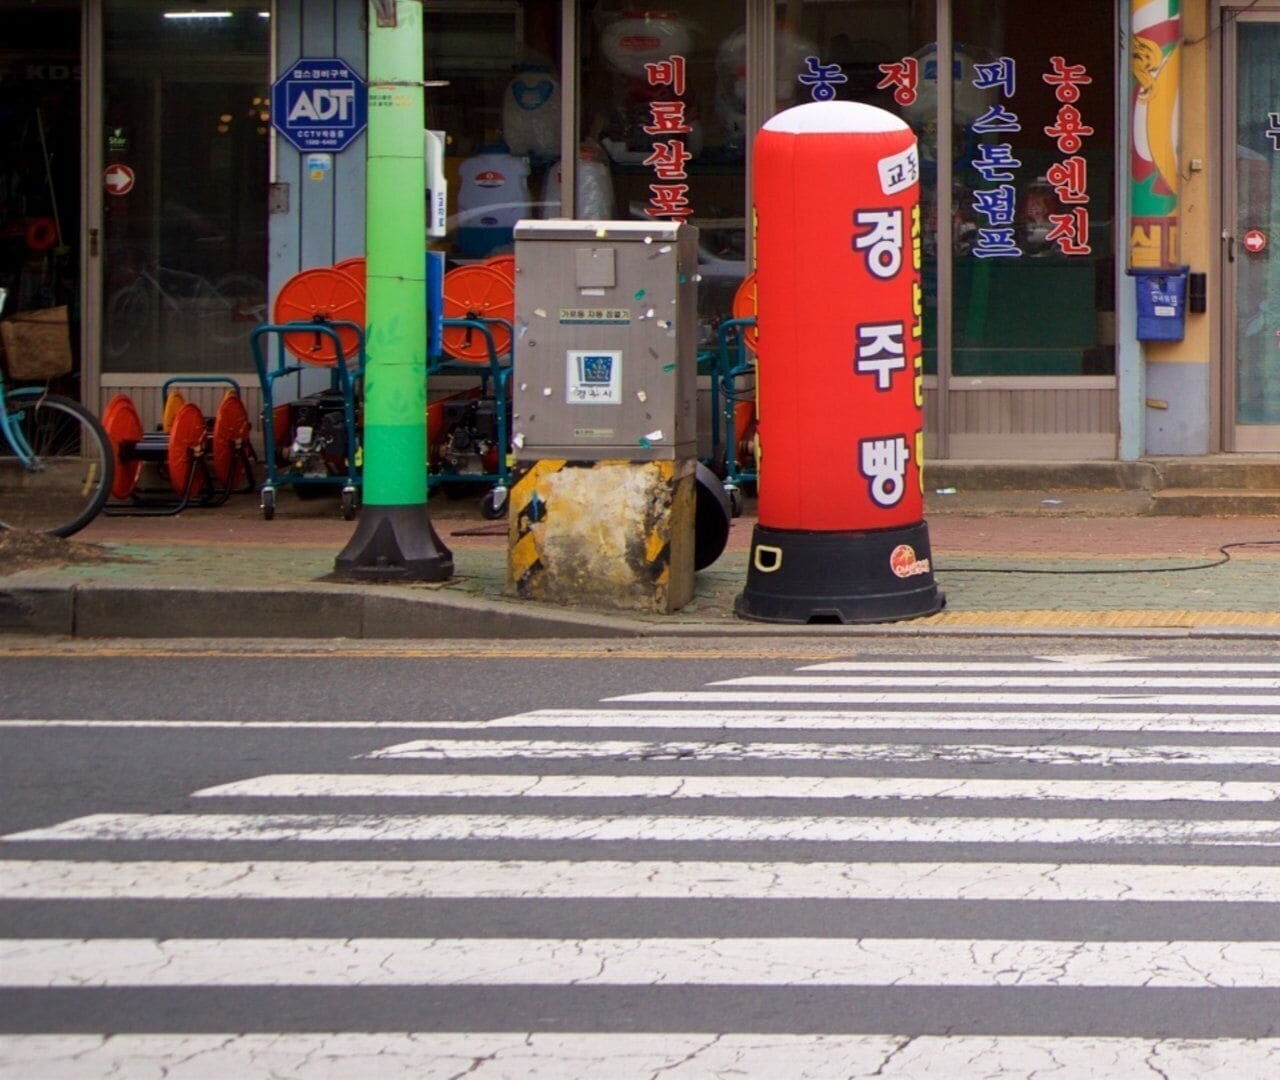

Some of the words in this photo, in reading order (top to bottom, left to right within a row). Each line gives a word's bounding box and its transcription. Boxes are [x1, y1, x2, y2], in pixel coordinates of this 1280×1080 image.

[288, 88, 354, 121] ADT
[643, 55, 693, 224] 비료살포
[853, 208, 909, 508] 경주빵
